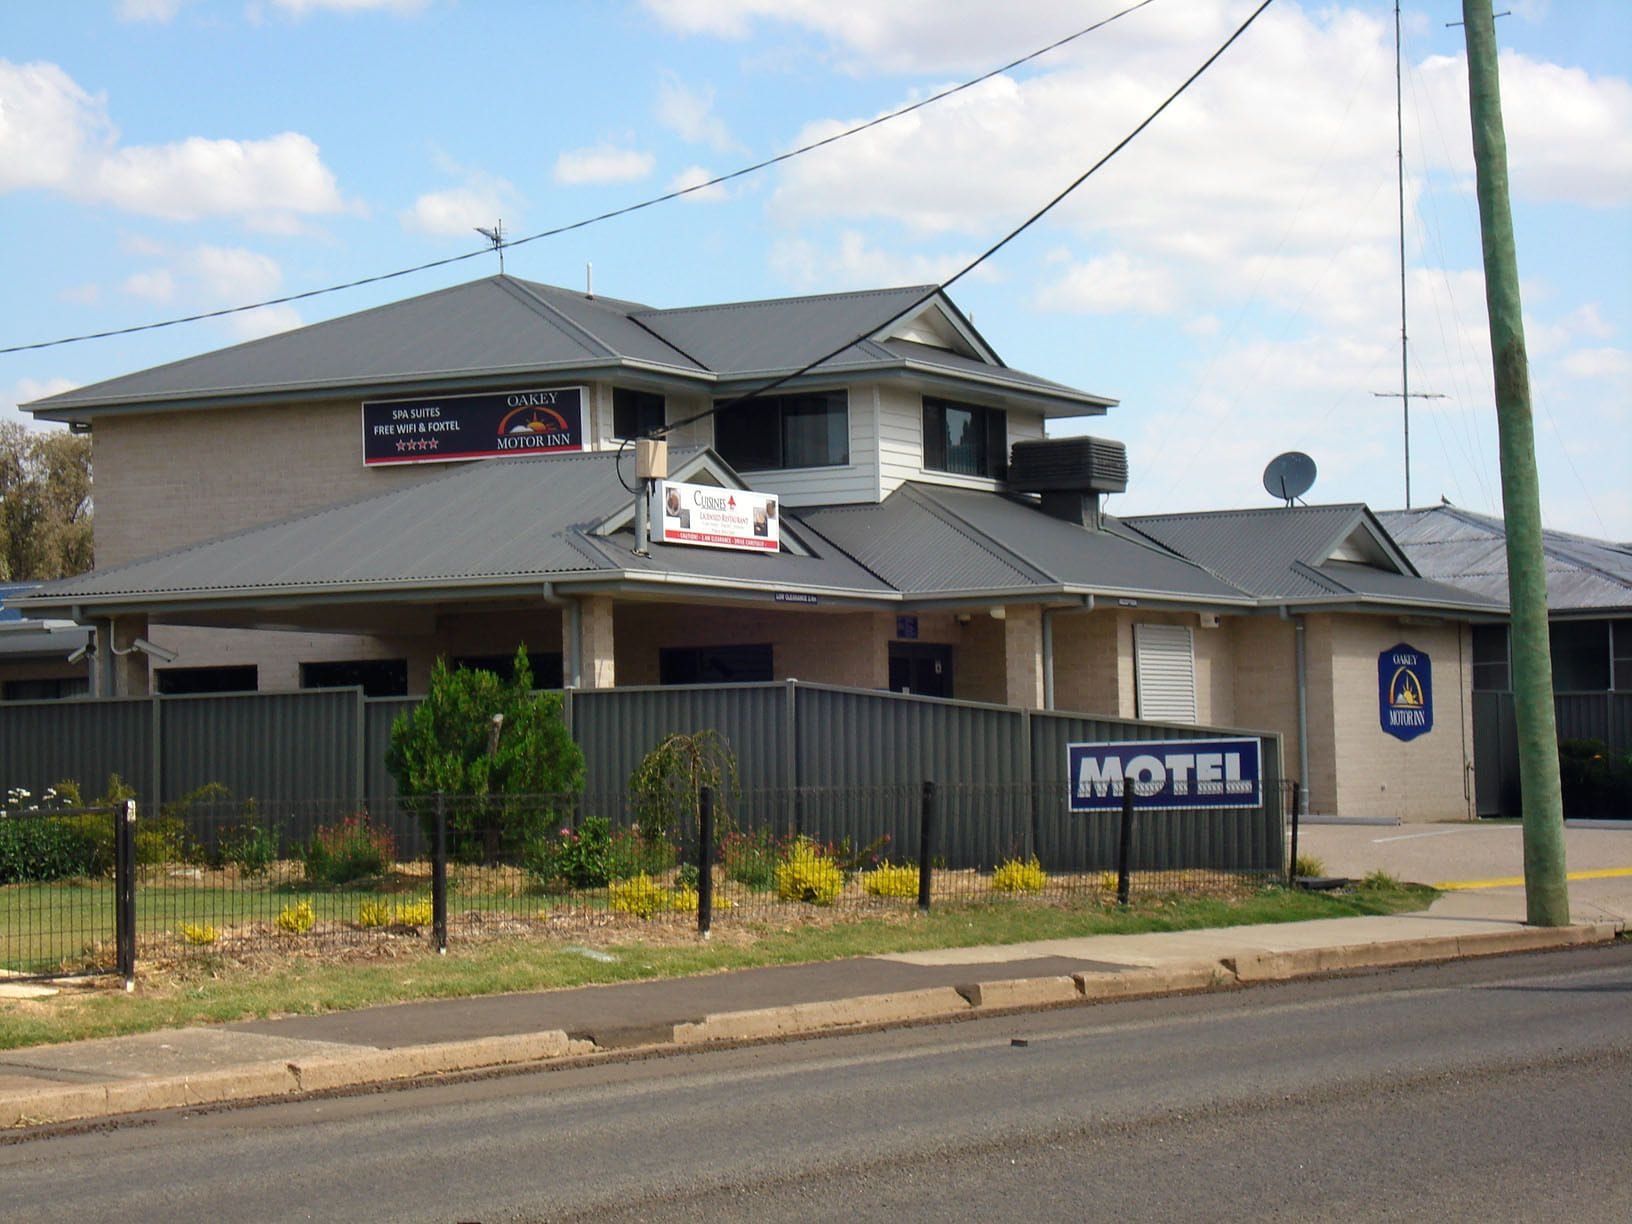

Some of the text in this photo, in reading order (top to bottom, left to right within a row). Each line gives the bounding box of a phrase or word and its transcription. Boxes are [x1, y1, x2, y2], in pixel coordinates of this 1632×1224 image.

[507, 392, 558, 407] OAKEY
[393, 407, 440, 420] SPA SUITES
[374, 421, 460, 436] FREE WIFI & FOXTEL
[497, 433, 570, 450] MOTOR INN
[1393, 654, 1418, 666] OAKEY
[1390, 709, 1425, 727] MOTOR INN
[1077, 752, 1252, 798] MOTEL
